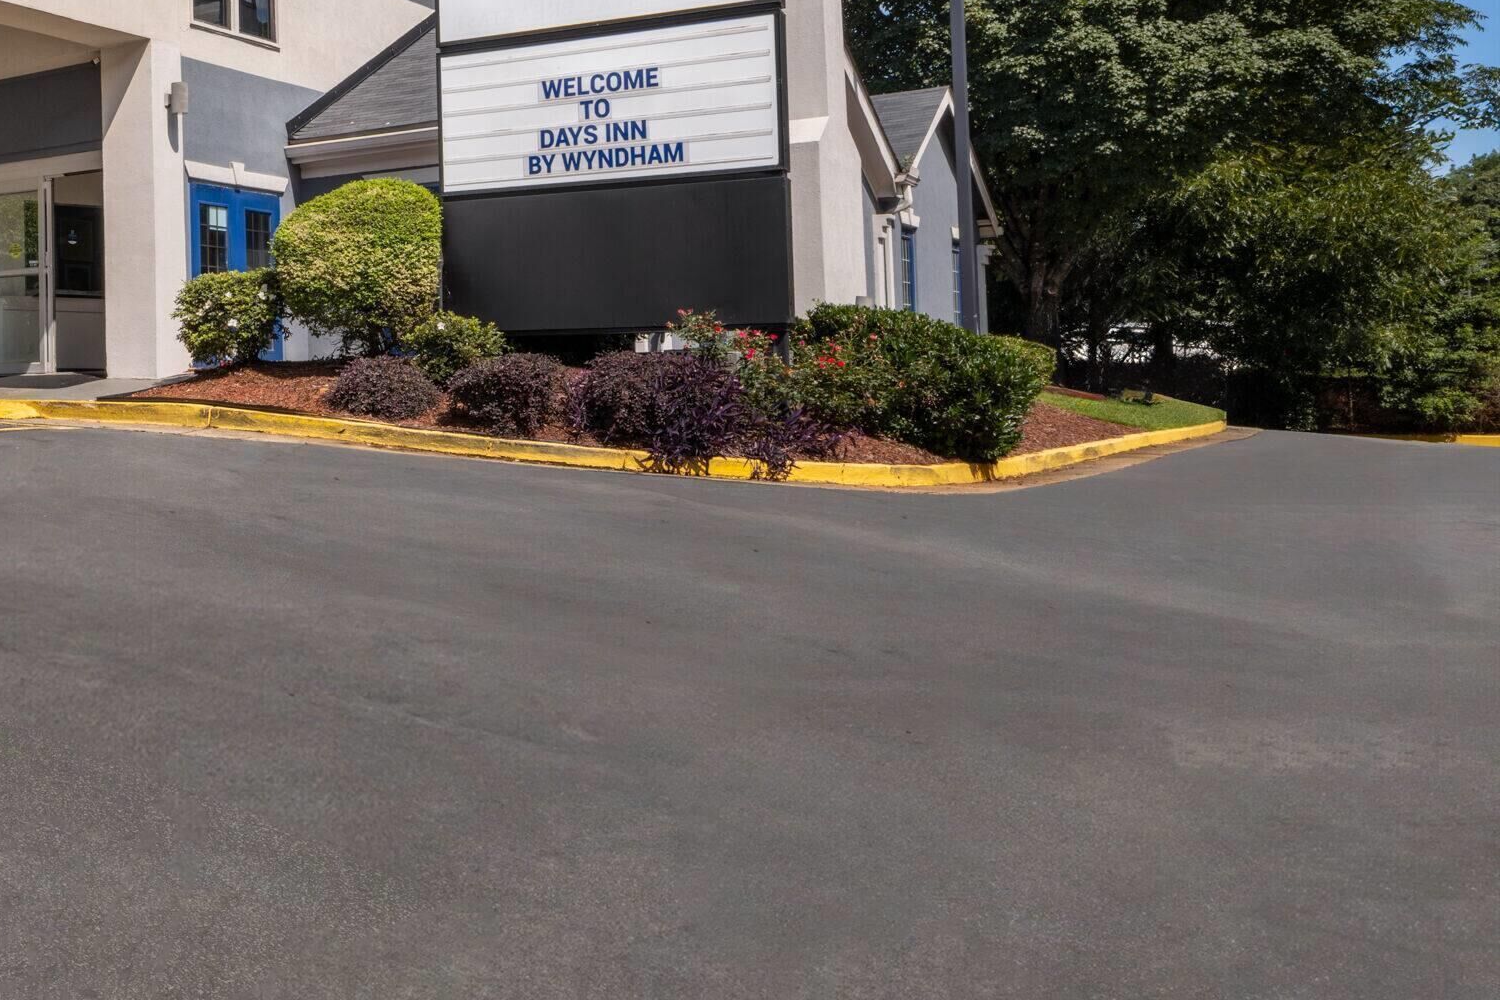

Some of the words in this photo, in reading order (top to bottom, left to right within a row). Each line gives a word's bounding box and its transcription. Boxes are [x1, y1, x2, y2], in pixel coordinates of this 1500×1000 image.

[542, 67, 659, 99] WELCOME
[580, 98, 610, 120] TO
[540, 125, 598, 149] DAYS
[605, 120, 647, 142] INN
[528, 154, 556, 175] BY
[562, 142, 684, 172] WYNDHAM
